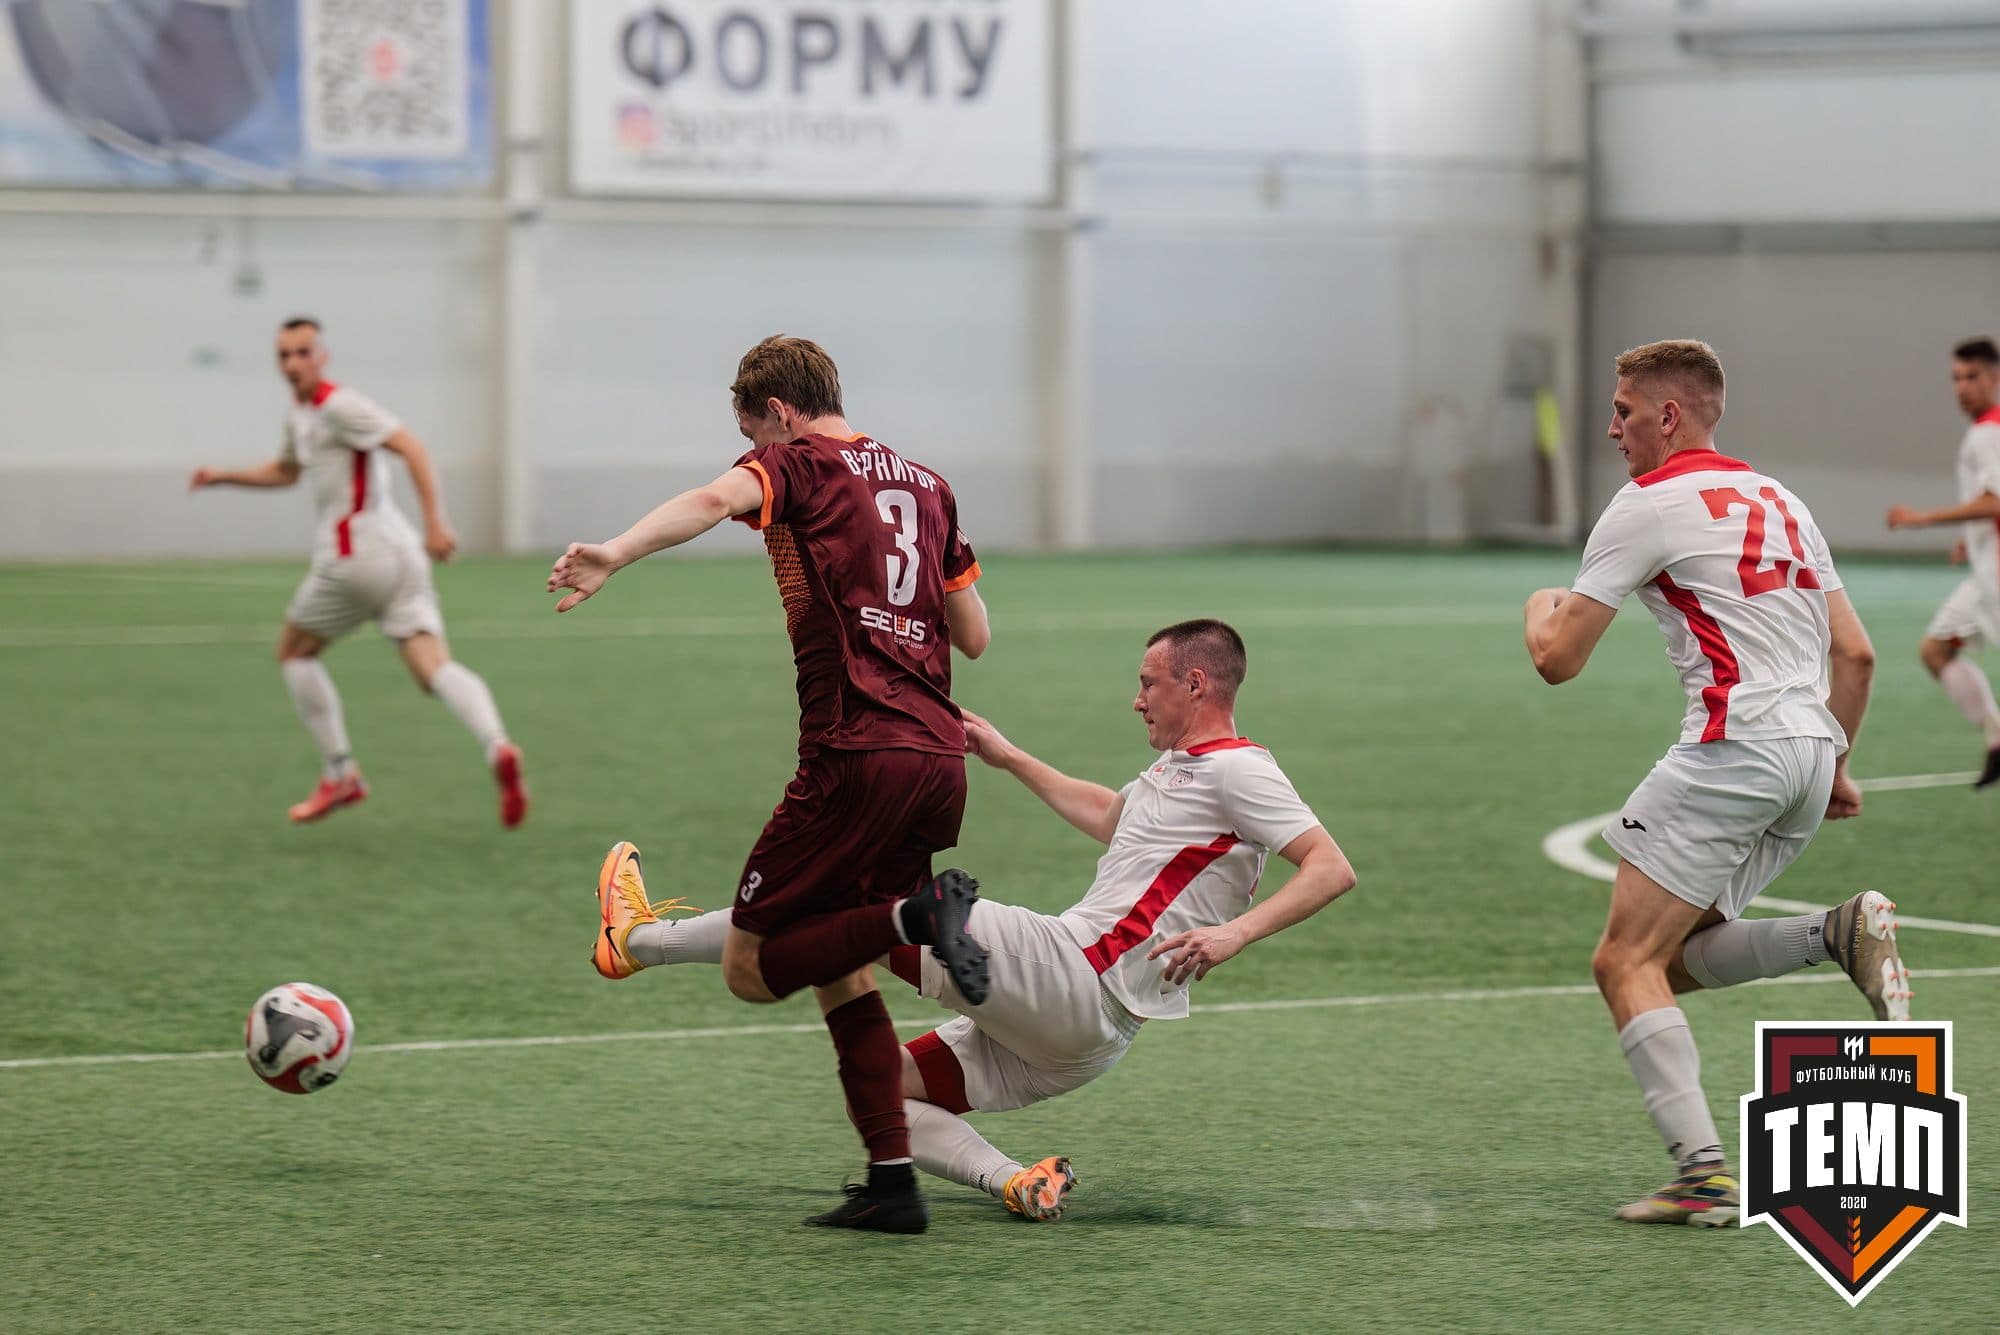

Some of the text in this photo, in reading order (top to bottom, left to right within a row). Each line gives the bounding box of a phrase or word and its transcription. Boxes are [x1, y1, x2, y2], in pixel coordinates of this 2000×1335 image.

[620, 7, 1003, 100] ФОРМУ
[875, 488, 920, 607] 3
[1698, 486, 1825, 598] 21
[860, 606, 927, 642] SEUS
[740, 870, 763, 903] 3
